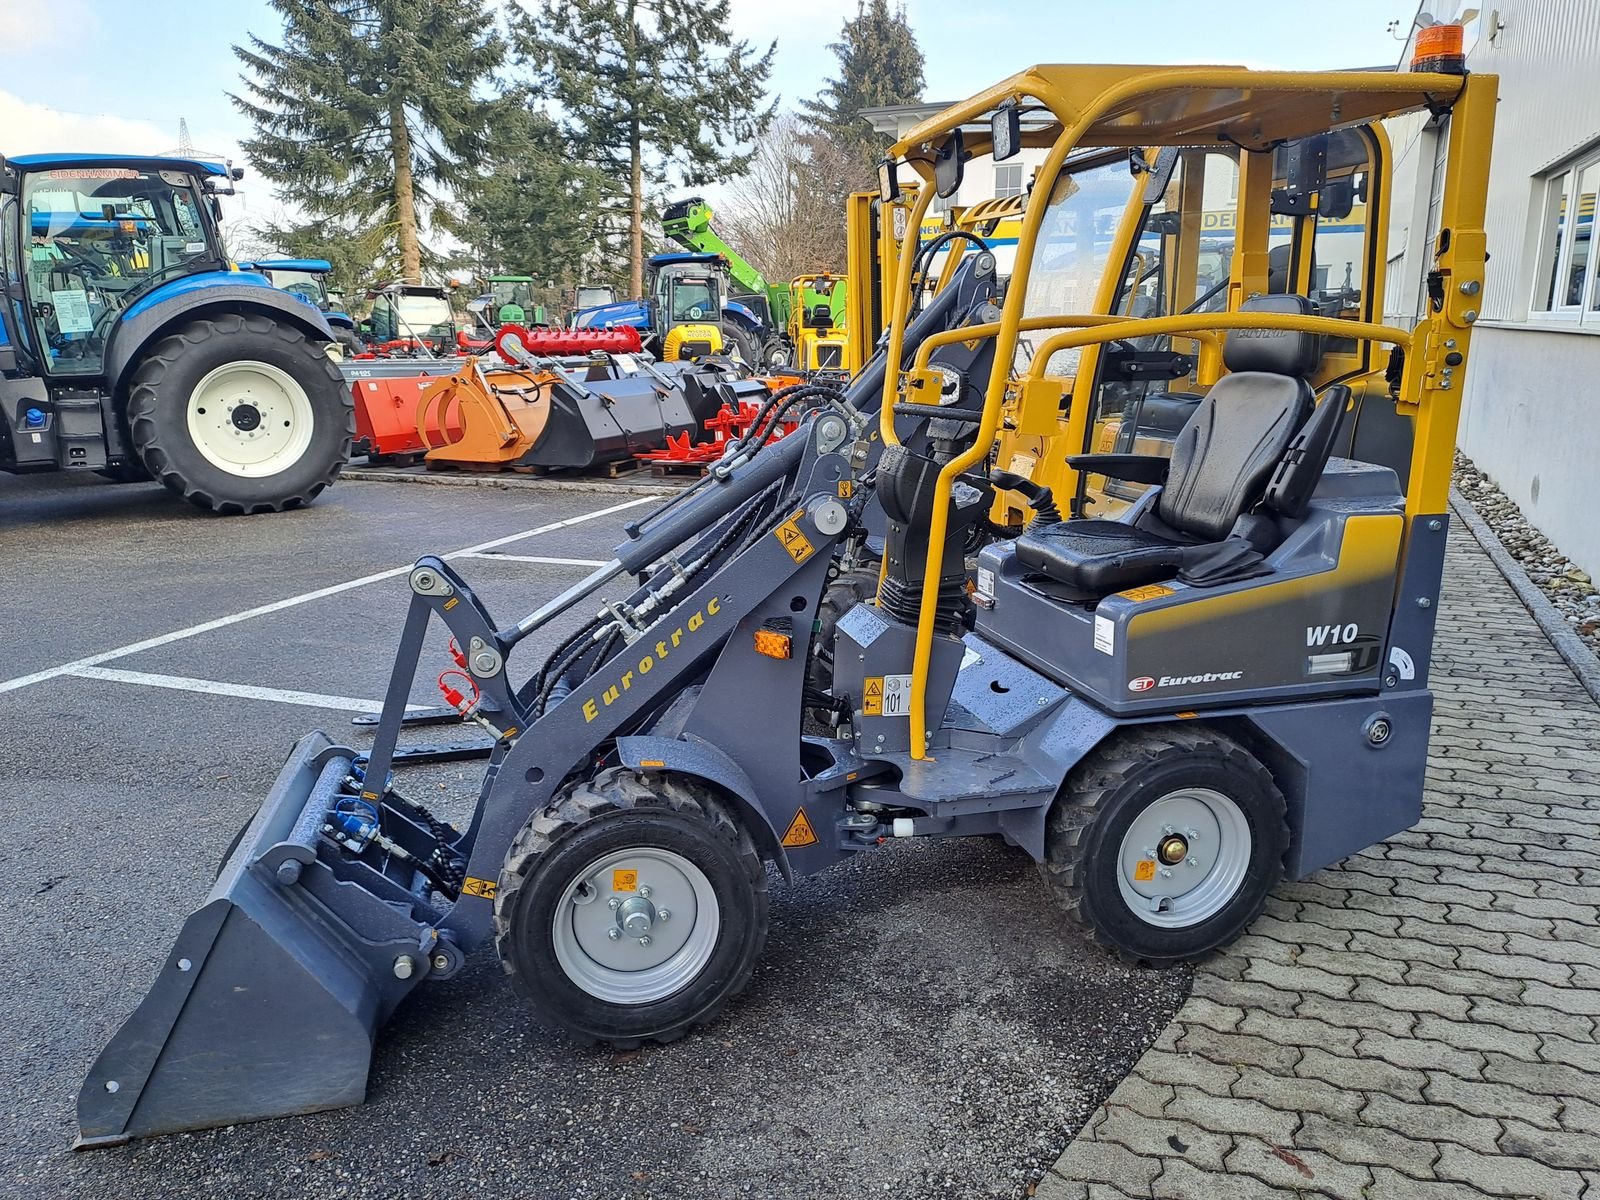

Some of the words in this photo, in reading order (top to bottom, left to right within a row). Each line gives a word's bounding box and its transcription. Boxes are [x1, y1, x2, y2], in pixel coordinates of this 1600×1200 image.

[50, 169, 139, 179] EIDENHAMMER
[920, 225, 940, 235] NEW
[692, 309, 700, 318] 20
[1306, 623, 1359, 647] W10
[581, 597, 721, 724] Eurotrac
[1157, 671, 1243, 688] Eurotrac
[885, 693, 901, 713] 101
